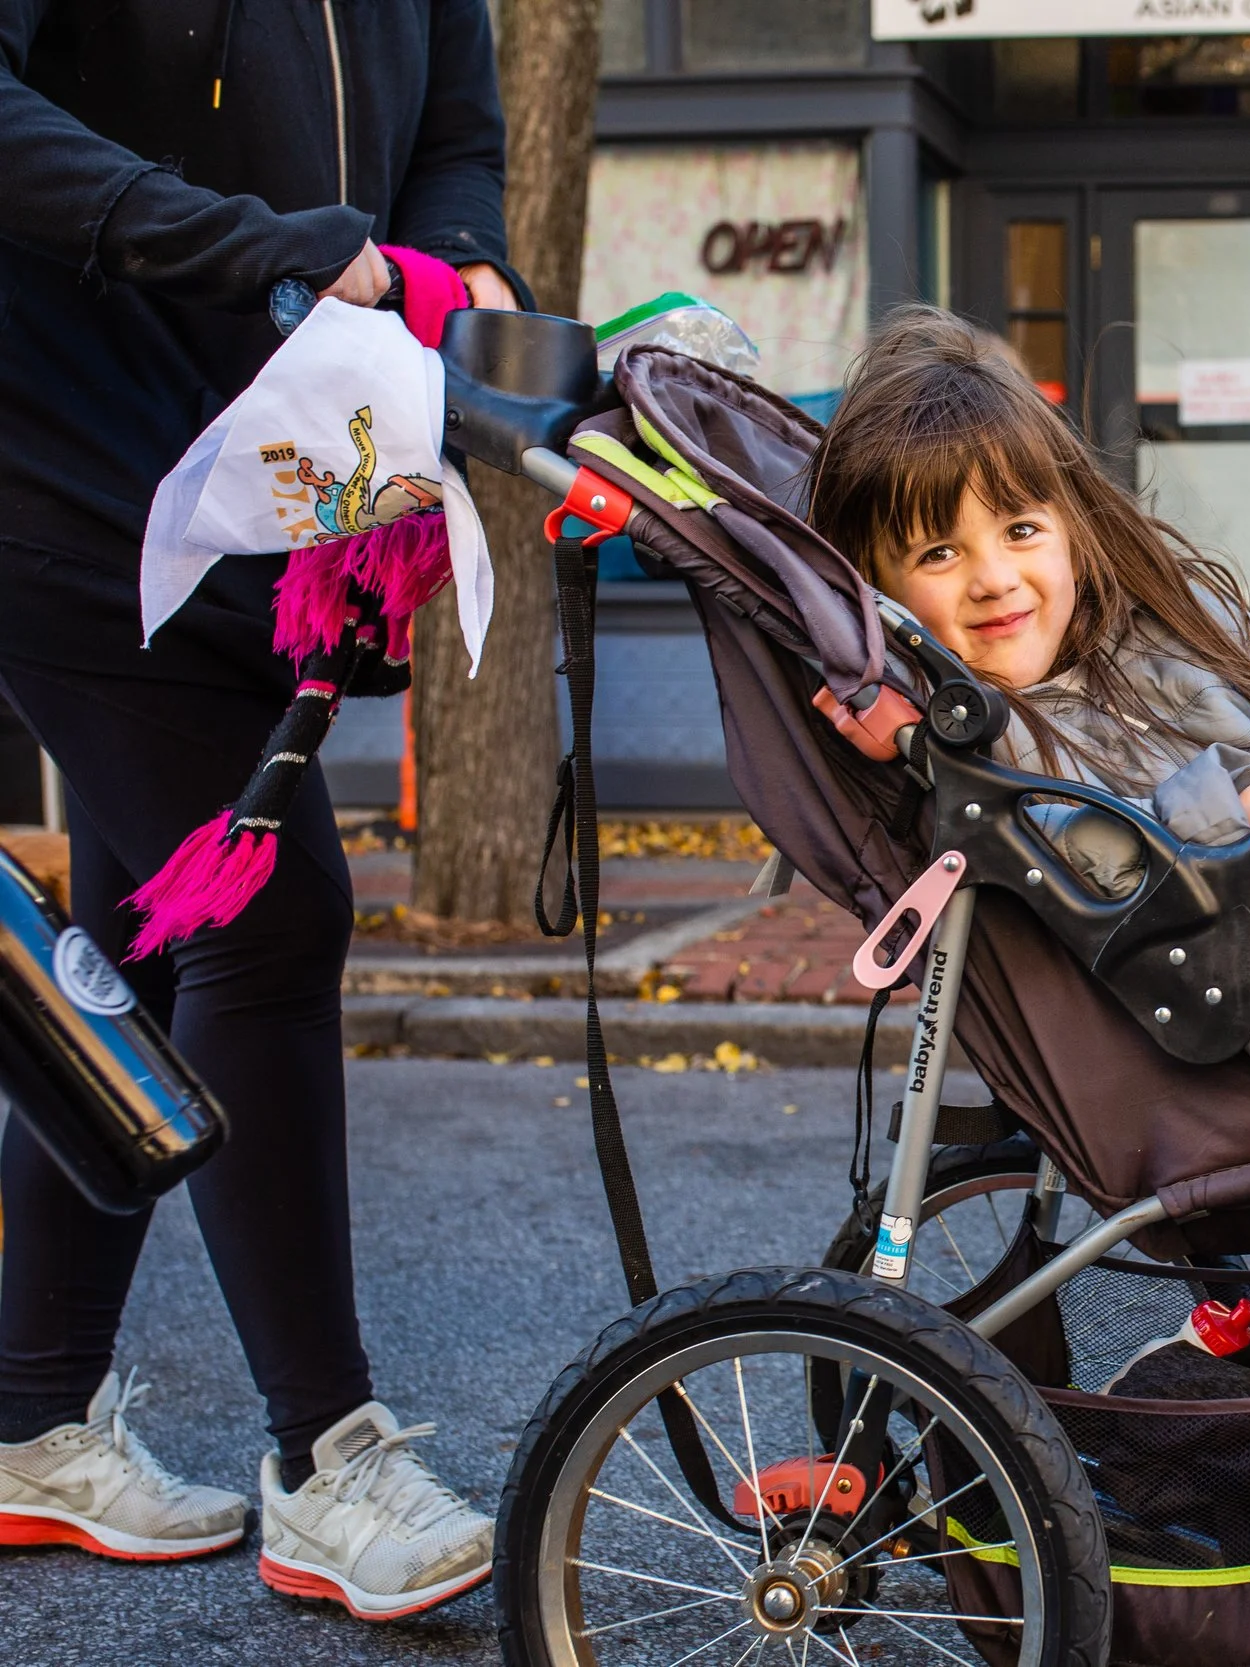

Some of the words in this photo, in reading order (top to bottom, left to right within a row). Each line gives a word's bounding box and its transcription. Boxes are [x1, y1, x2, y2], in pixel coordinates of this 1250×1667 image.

[1135, 0, 1232, 18] ASIAN
[700, 212, 847, 276] OPEN
[352, 427, 367, 452] Move
[260, 448, 296, 463] 2019
[360, 453, 371, 474] Your
[345, 489, 355, 499] So
[342, 499, 351, 525] Others
[908, 1035, 936, 1094] baby
[922, 949, 948, 1015] trend
